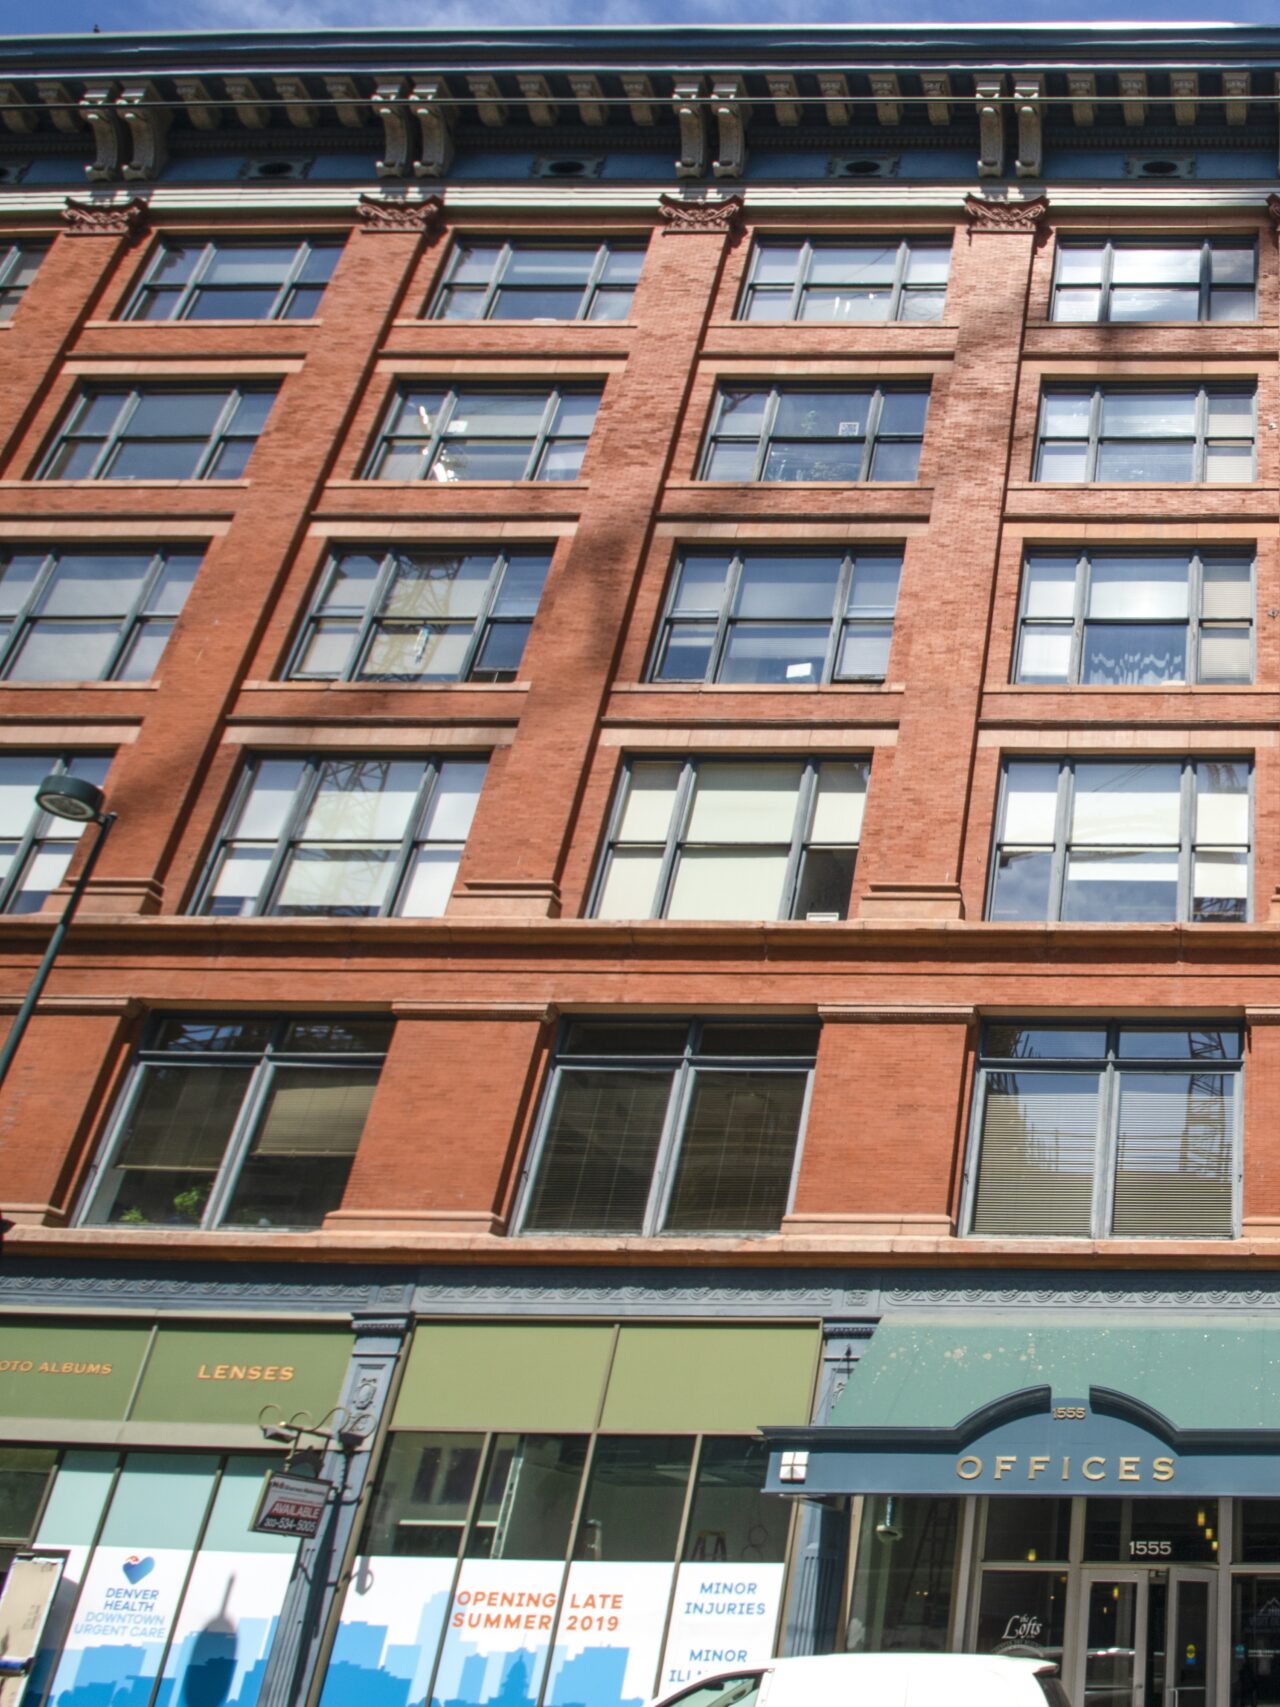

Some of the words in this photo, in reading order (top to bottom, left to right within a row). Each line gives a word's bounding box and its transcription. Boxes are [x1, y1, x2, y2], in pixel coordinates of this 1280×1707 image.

[0, 1360, 33, 1373] OTO
[38, 1361, 113, 1376] ALBUMS
[196, 1364, 295, 1381] LENSES
[1052, 1407, 1086, 1420] 1555
[955, 1455, 1175, 1481] OFFICES
[271, 1502, 320, 1519] AVAILABLE
[1129, 1541, 1172, 1555] 1555
[105, 1587, 159, 1600] DENVER
[699, 1582, 757, 1595] MINOR
[103, 1600, 155, 1612] HEALTH
[456, 1591, 557, 1608] OPENING
[569, 1593, 624, 1609] LATE
[684, 1602, 766, 1615] INJURIES
[84, 1611, 165, 1625] DOWNTOWN
[451, 1612, 553, 1630] SUMMER
[566, 1615, 619, 1631] 2019
[74, 1623, 129, 1636] URGENT
[129, 1626, 166, 1638] CARE
[1001, 1615, 1043, 1638] Lofts
[689, 1649, 748, 1662] MINOR
